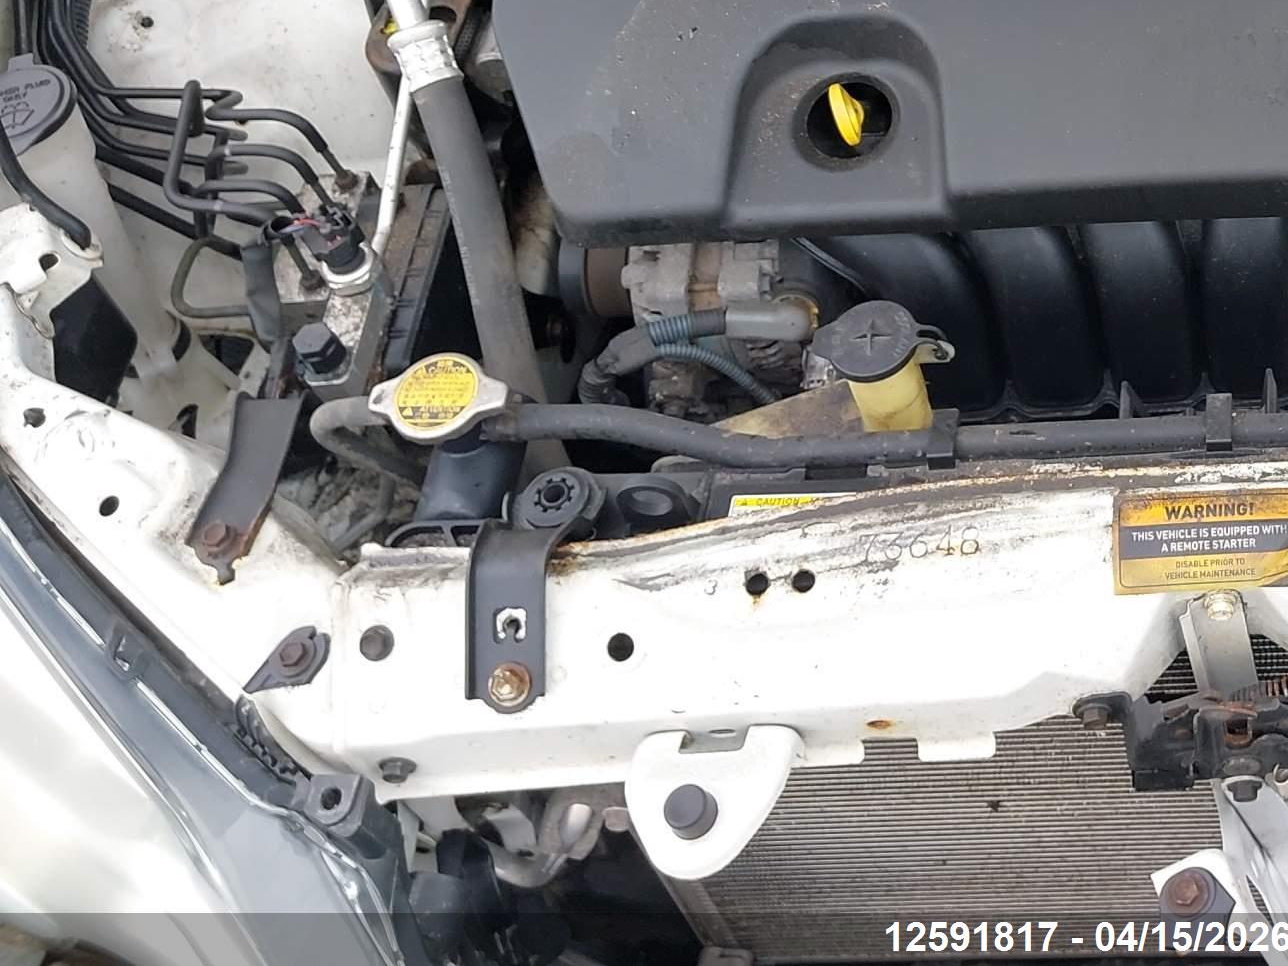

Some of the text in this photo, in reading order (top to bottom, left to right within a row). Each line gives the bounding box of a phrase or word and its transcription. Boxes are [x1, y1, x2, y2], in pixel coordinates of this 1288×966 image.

[756, 497, 799, 506] CAUTION
[1165, 502, 1254, 520] WARNING!
[1132, 524, 1288, 541] THIS VEHICLE IS EQUIPPED WITH
[1161, 538, 1256, 552] A REMOTE STARTER
[1175, 557, 1245, 569] DISABLE PRIOR TO
[1165, 568, 1256, 580] VEHICLE MAINTENANCE
